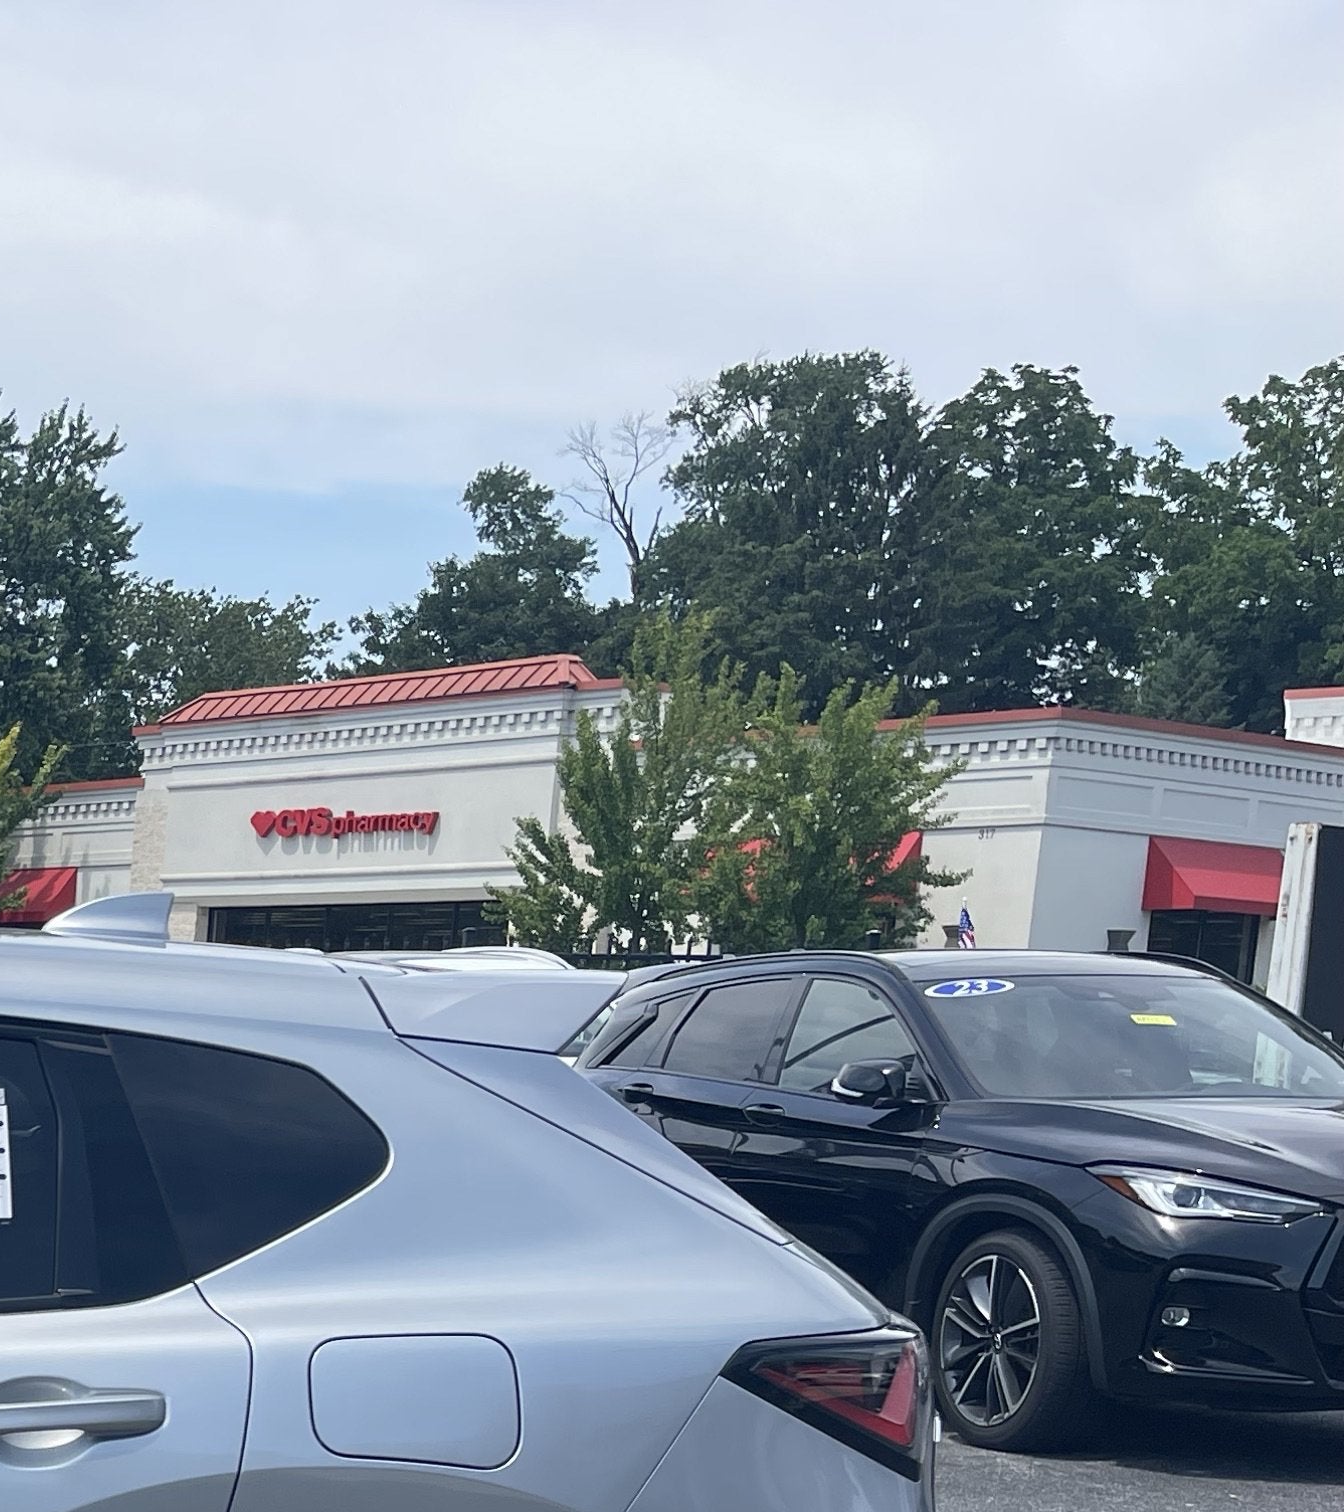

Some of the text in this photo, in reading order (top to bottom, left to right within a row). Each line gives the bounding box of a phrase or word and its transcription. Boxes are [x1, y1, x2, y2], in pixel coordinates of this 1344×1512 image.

[275, 807, 440, 839] CVS pharmacy
[978, 828, 996, 840] 317
[953, 980, 989, 996] 23
